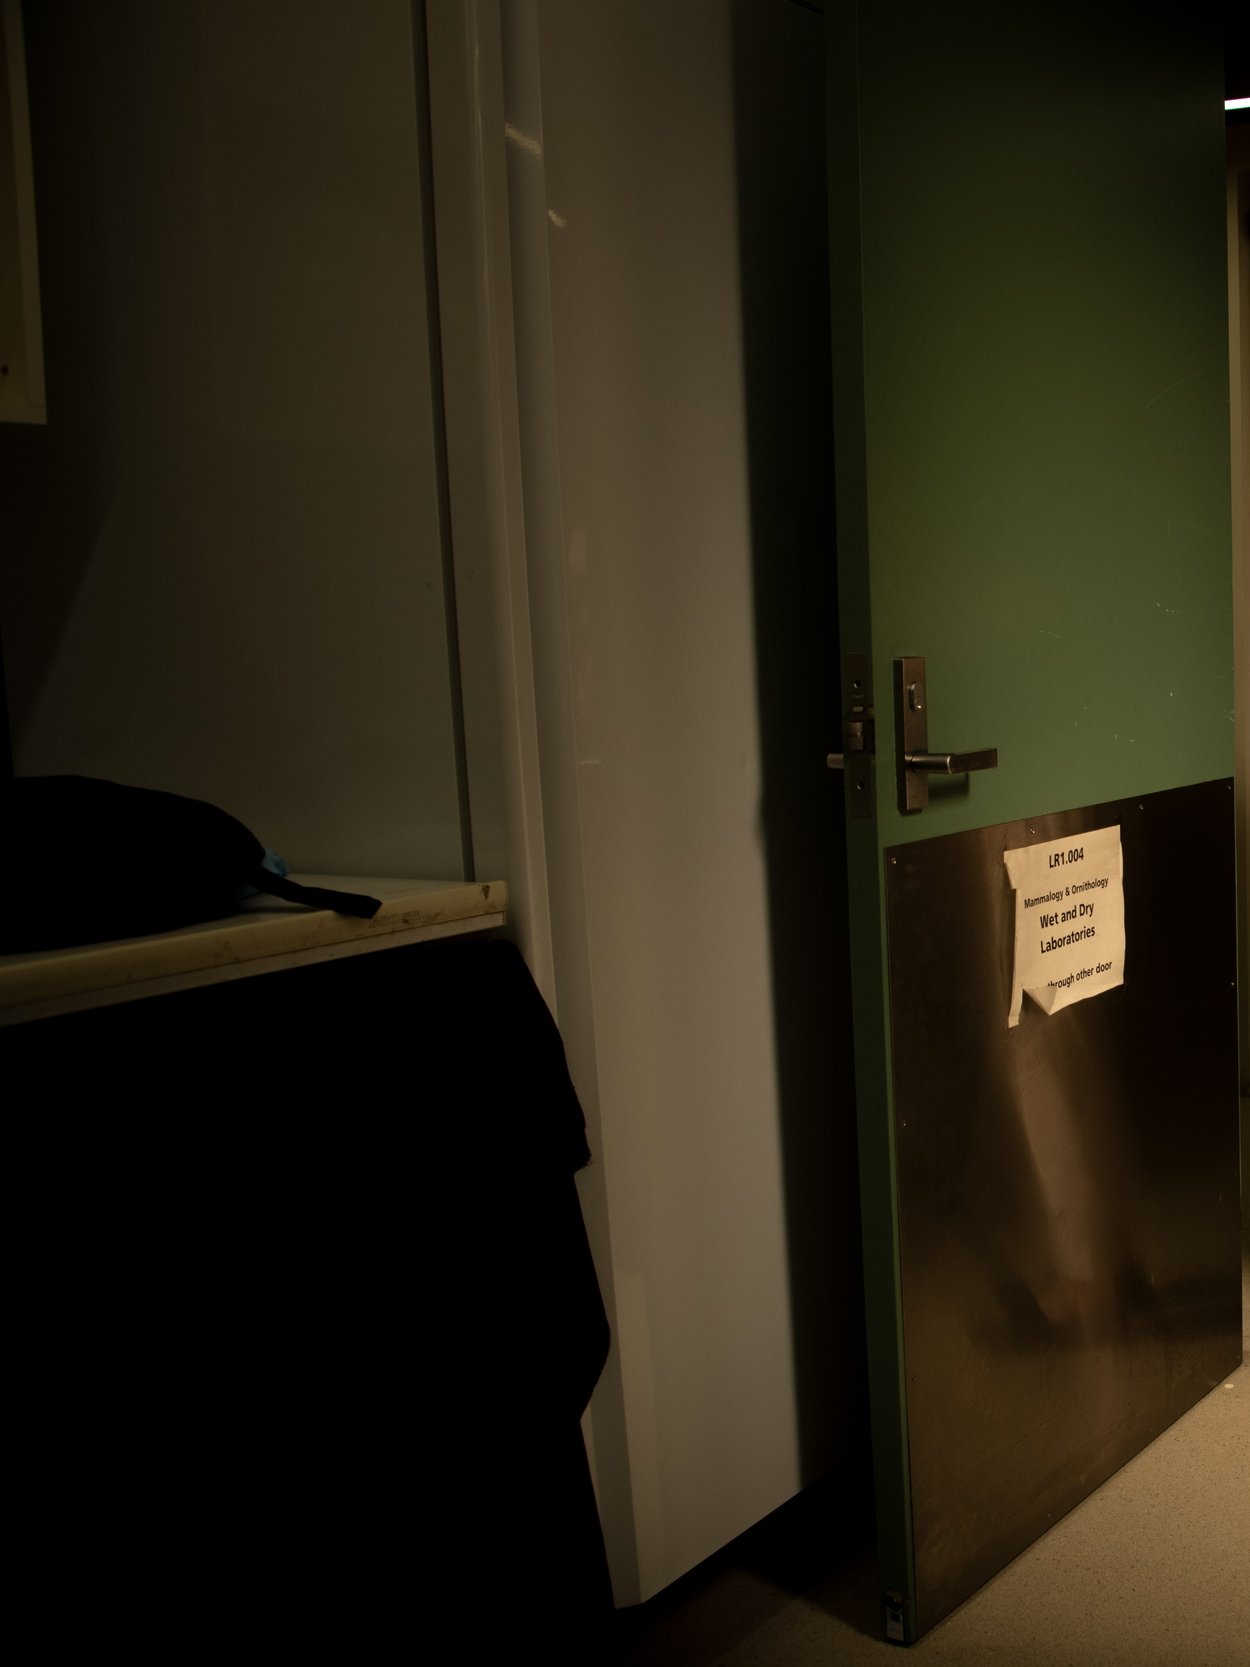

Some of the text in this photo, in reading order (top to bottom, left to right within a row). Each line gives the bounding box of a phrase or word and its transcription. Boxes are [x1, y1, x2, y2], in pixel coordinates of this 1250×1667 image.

[1049, 847, 1084, 869] LR1.004
[1024, 877, 1109, 909] Mammalogy & Ornithology
[1040, 902, 1095, 929] Wet and Dry
[1040, 925, 1095, 954] Laboratories
[1076, 968, 1094, 981] other
[1096, 961, 1112, 974] door
